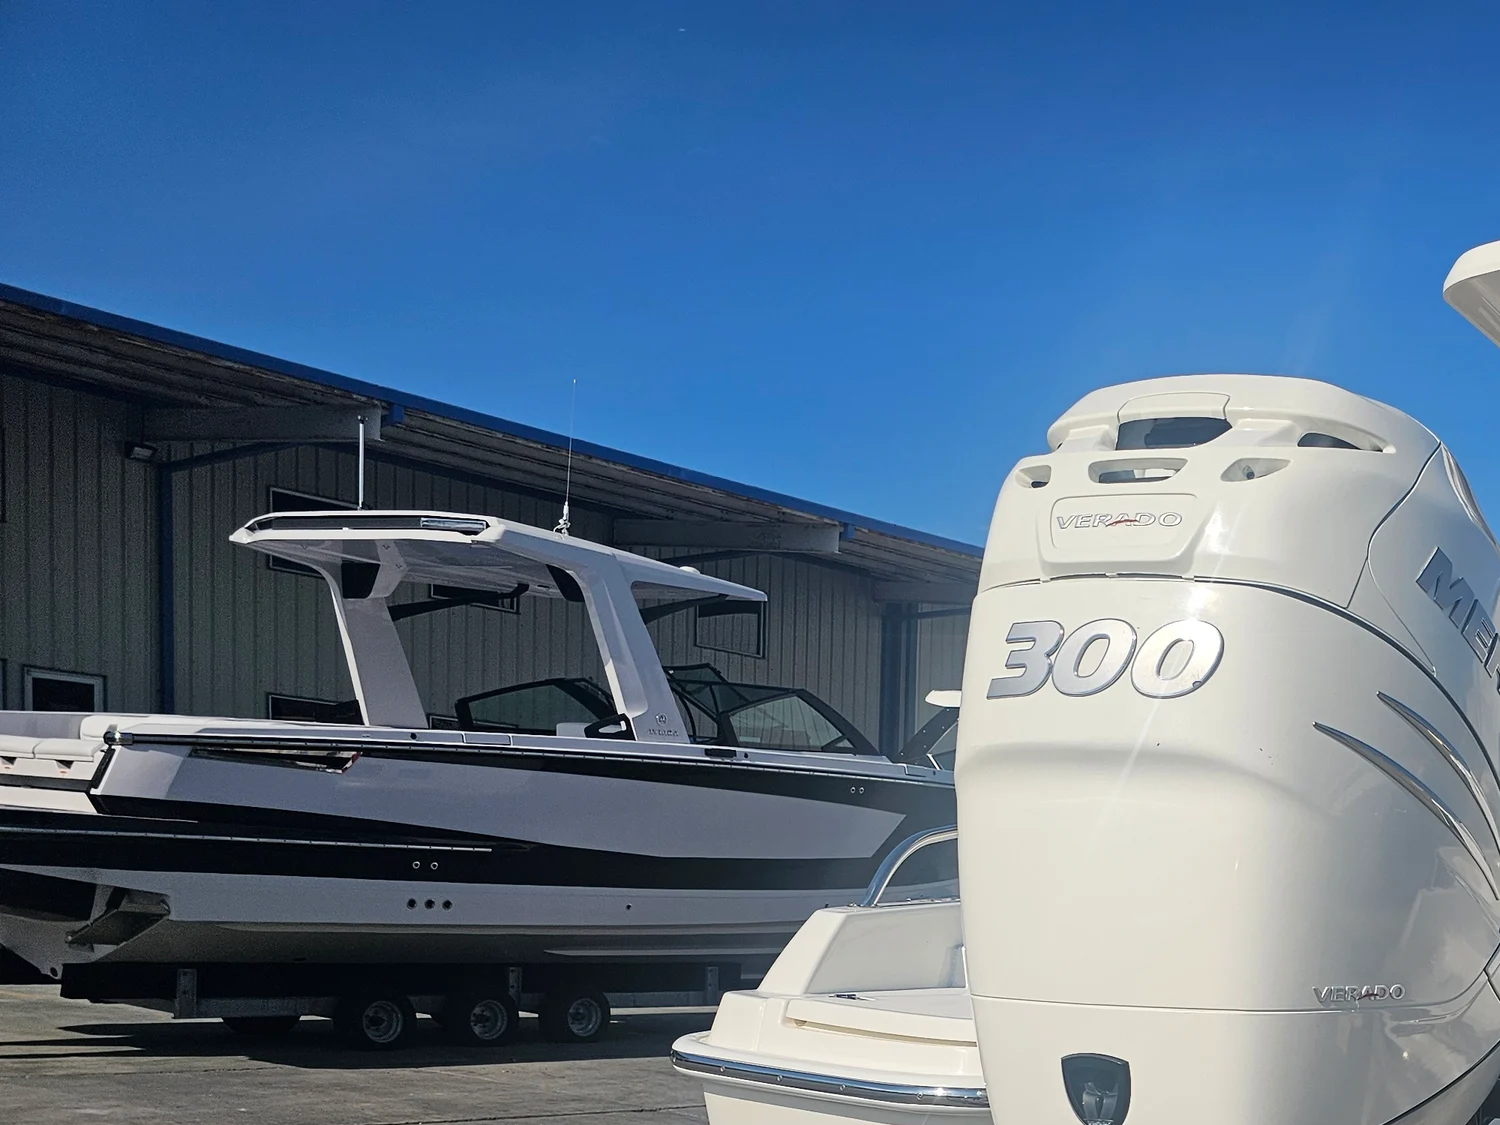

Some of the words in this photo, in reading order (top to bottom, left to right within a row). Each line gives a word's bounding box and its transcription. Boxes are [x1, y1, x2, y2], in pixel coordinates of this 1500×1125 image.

[1056, 510, 1183, 531] VERADO
[986, 617, 1224, 700] 300
[1311, 983, 1406, 1003] VERADO
